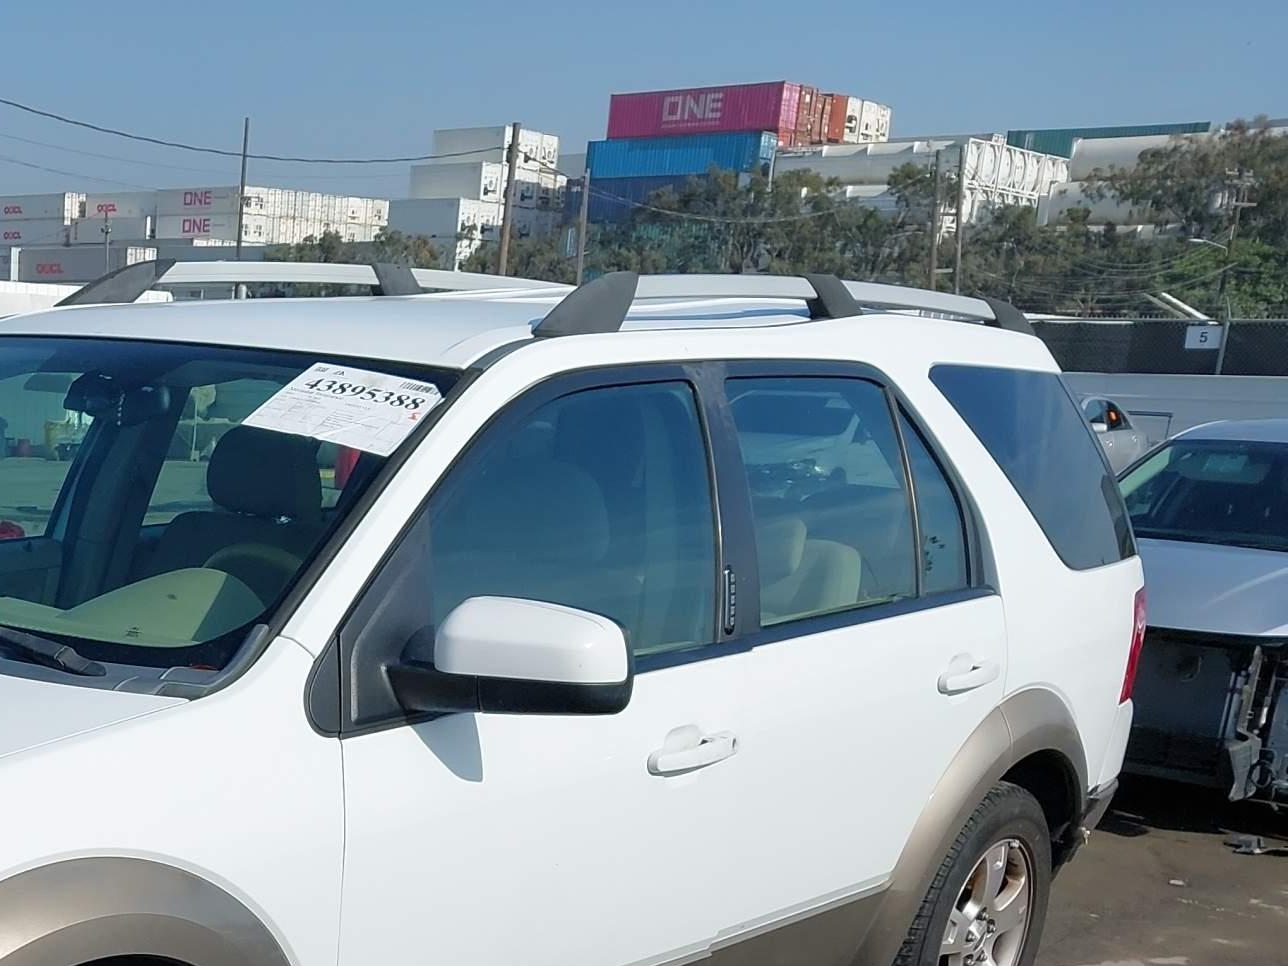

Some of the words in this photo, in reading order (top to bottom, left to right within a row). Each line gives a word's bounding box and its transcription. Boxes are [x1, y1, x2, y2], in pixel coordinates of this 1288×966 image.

[663, 93, 722, 120] ONE
[183, 191, 212, 206] ONE
[182, 218, 211, 233] ONE
[1199, 331, 1209, 343] 5
[305, 378, 425, 410] 43895388
